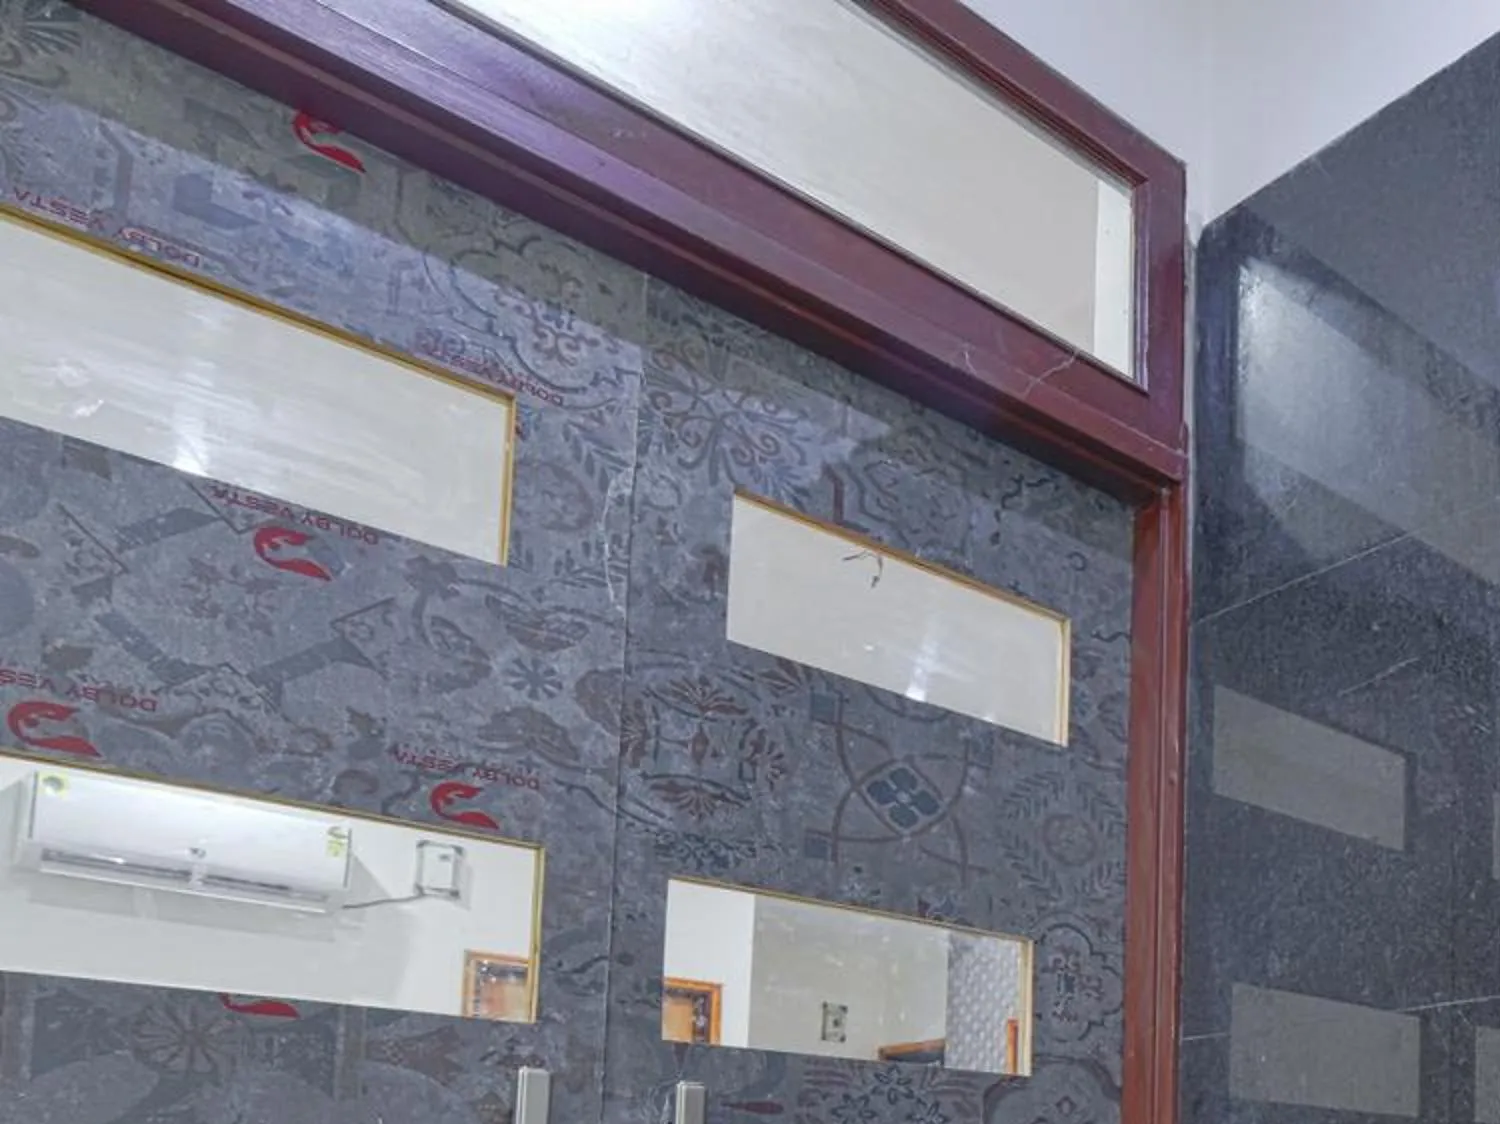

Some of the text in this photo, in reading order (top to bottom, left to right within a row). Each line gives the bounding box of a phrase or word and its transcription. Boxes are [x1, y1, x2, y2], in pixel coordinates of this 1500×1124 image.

[13, 187, 105, 228] VESTA
[209, 485, 379, 545] DOLBY VESTA
[0, 669, 157, 711] DOLBY VES
[390, 745, 540, 789] DOLBY VESTA
